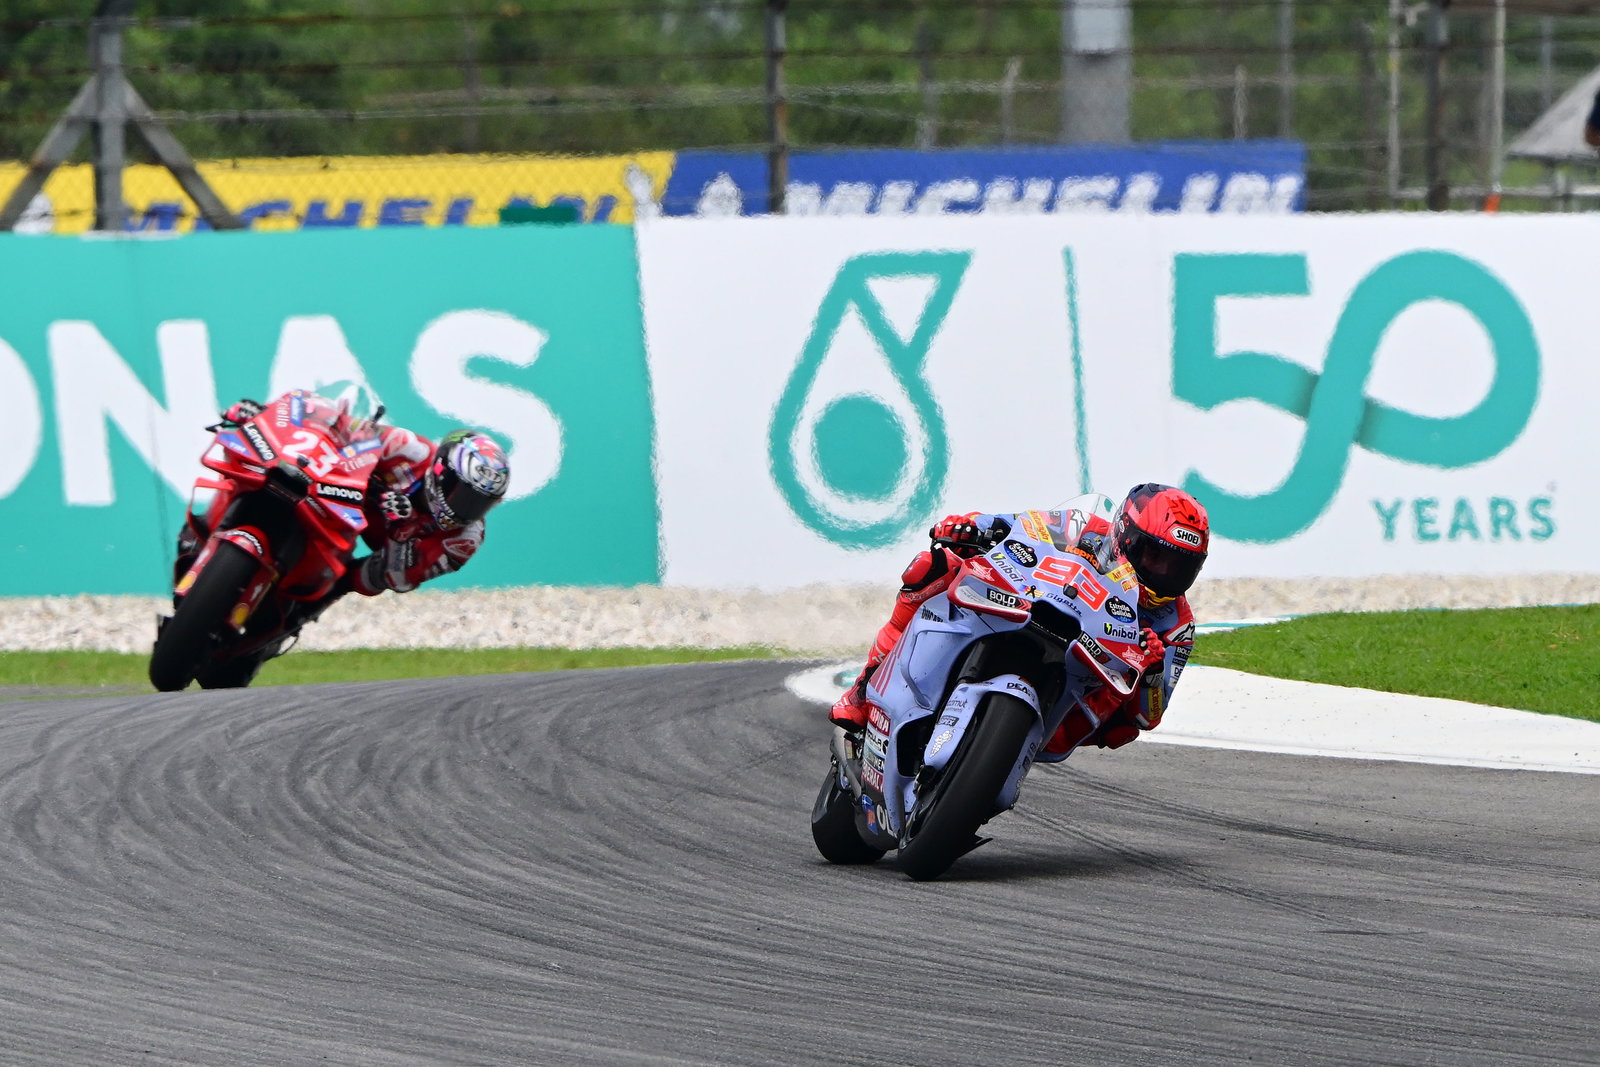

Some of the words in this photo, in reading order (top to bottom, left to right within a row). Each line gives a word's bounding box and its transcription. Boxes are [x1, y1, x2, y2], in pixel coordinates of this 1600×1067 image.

[1171, 248, 1542, 545] 50
[243, 422, 275, 461] Lenovo
[282, 431, 340, 477] 23
[317, 483, 363, 501] Lenovo
[1371, 498, 1557, 543] YEARS
[1176, 530, 1200, 545] SHOEI
[990, 551, 1024, 582] Unibat
[989, 590, 1016, 605] BOLD
[1032, 556, 1111, 612] 93
[1080, 633, 1102, 656] BOLD
[1103, 622, 1138, 640] Unibat
